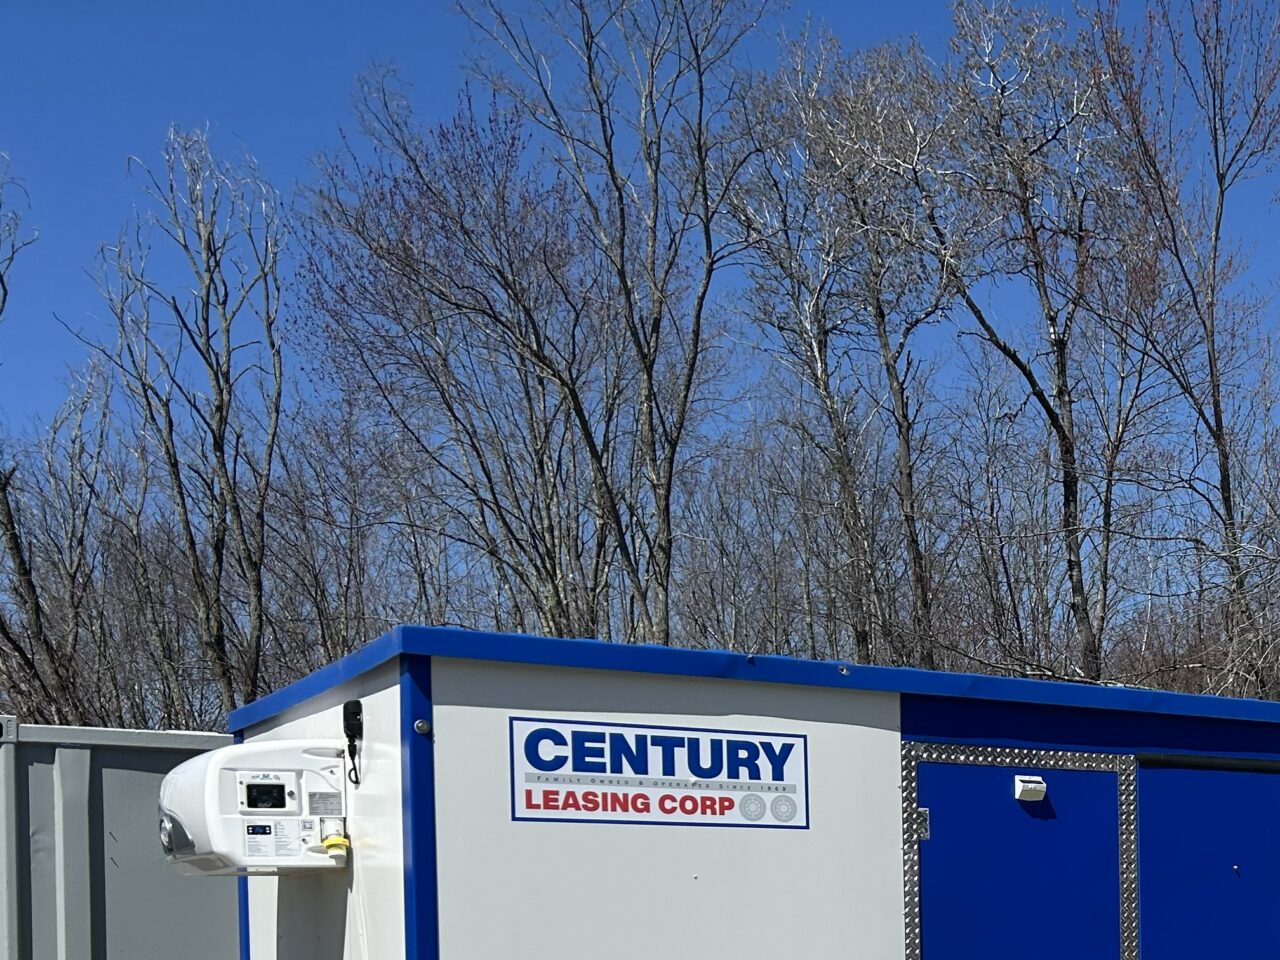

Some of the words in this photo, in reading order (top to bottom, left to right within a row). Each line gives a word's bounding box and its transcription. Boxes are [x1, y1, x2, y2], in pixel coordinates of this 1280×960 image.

[524, 727, 795, 782] CENTURY
[525, 789, 650, 813] LEASING
[658, 794, 735, 816] CORP
